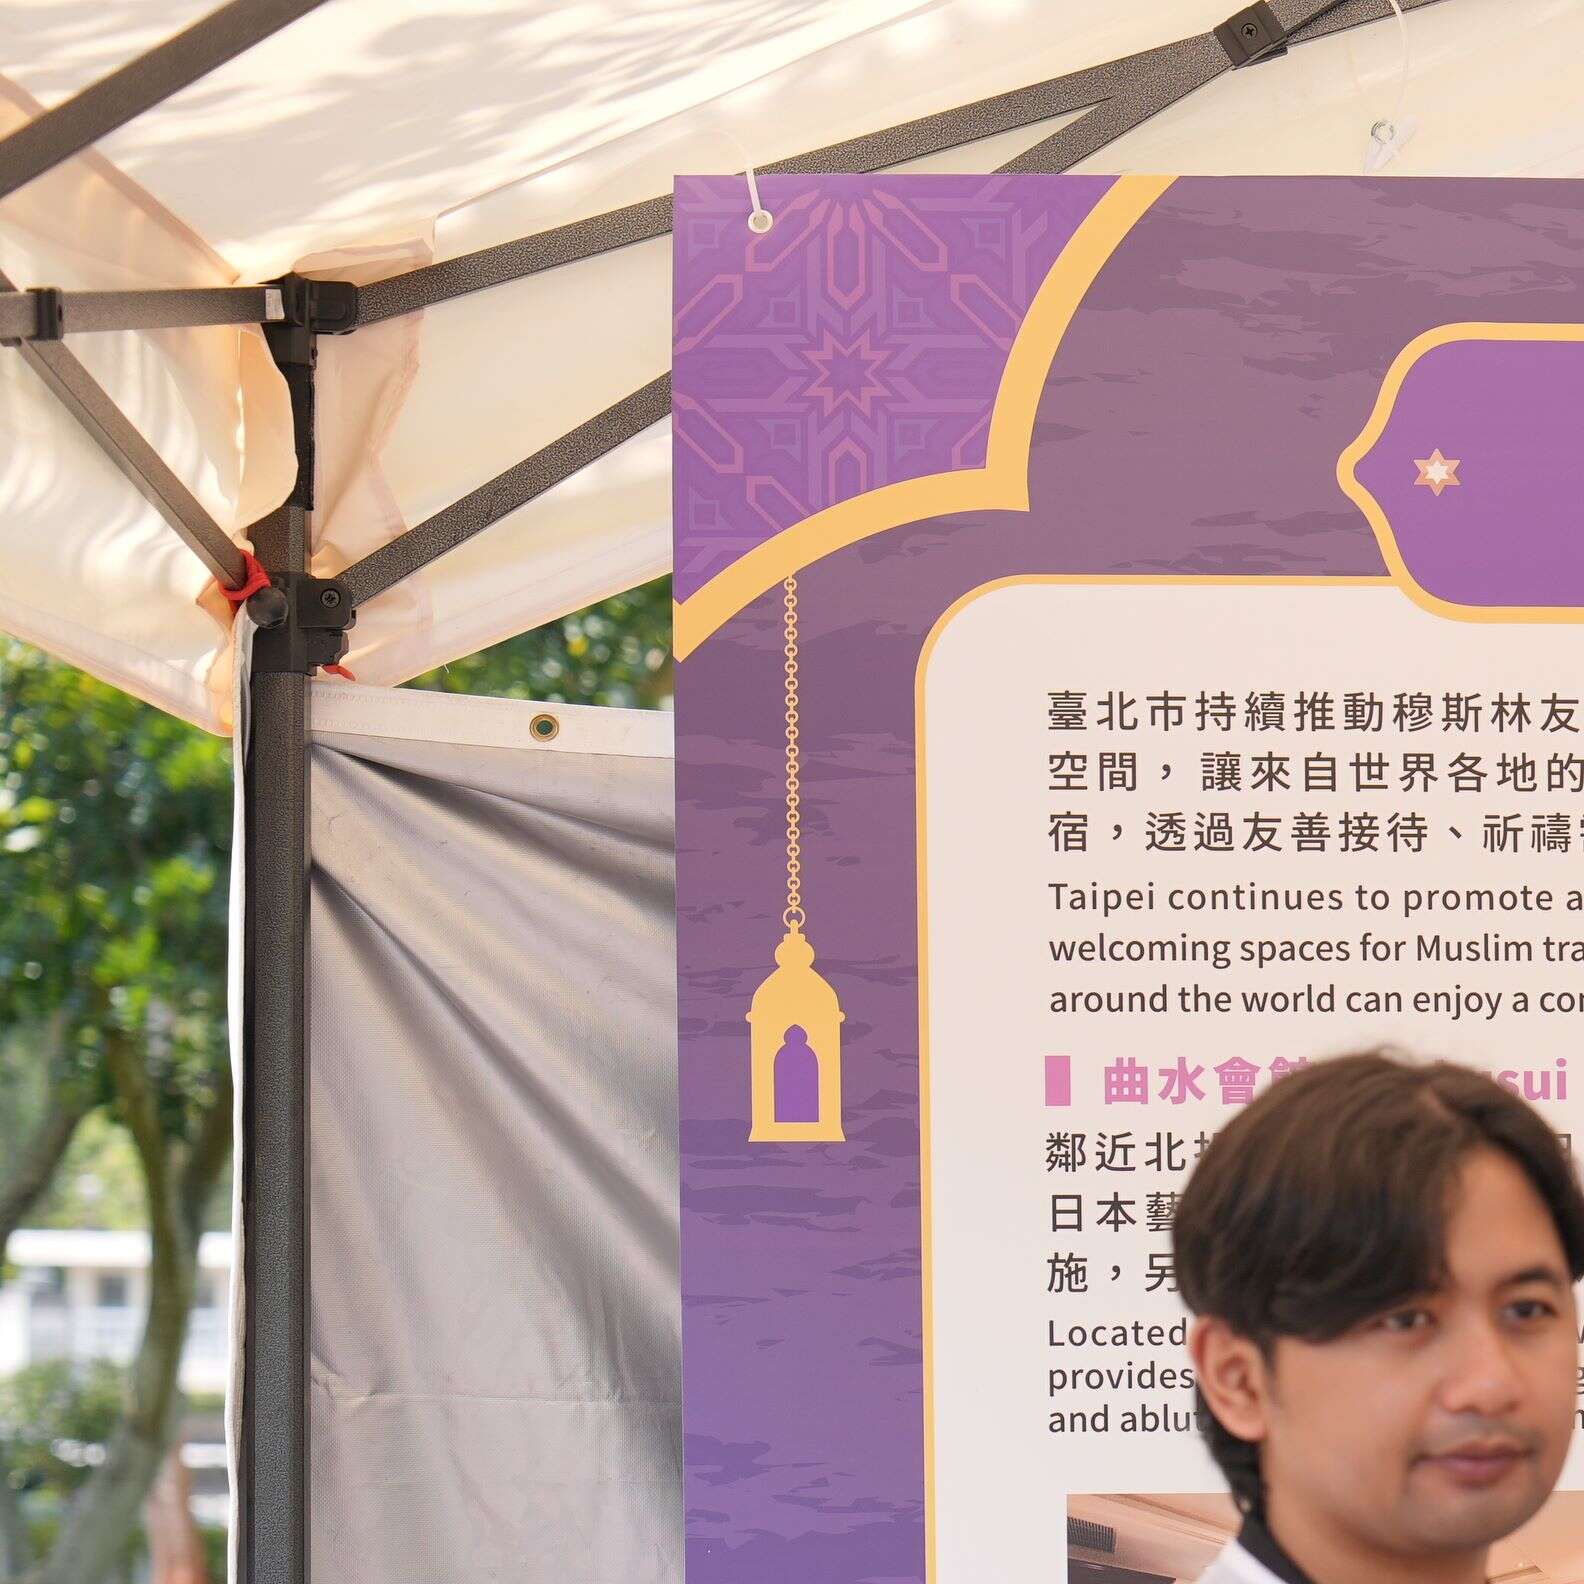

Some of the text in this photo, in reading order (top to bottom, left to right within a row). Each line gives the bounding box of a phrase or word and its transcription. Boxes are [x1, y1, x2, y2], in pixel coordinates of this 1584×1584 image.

[1048, 882, 1153, 917] Taipei
[1169, 882, 1343, 910] continues
[1355, 885, 1389, 910] to
[1404, 886, 1552, 917] promote
[1567, 891, 1582, 910] a
[1049, 933, 1231, 969] welcoming
[1240, 941, 1350, 968] spaces
[1360, 932, 1406, 961] for
[1417, 933, 1532, 961] Muslim
[1050, 984, 1167, 1012] around
[1178, 984, 1231, 1012] the
[1241, 984, 1335, 1012] world
[1346, 992, 1402, 1012] can
[1413, 985, 1502, 1020] enjoy
[1512, 992, 1528, 1012] a
[1049, 1317, 1187, 1347] Located
[1049, 1361, 1195, 1397] provides
[1049, 1404, 1109, 1433] and
